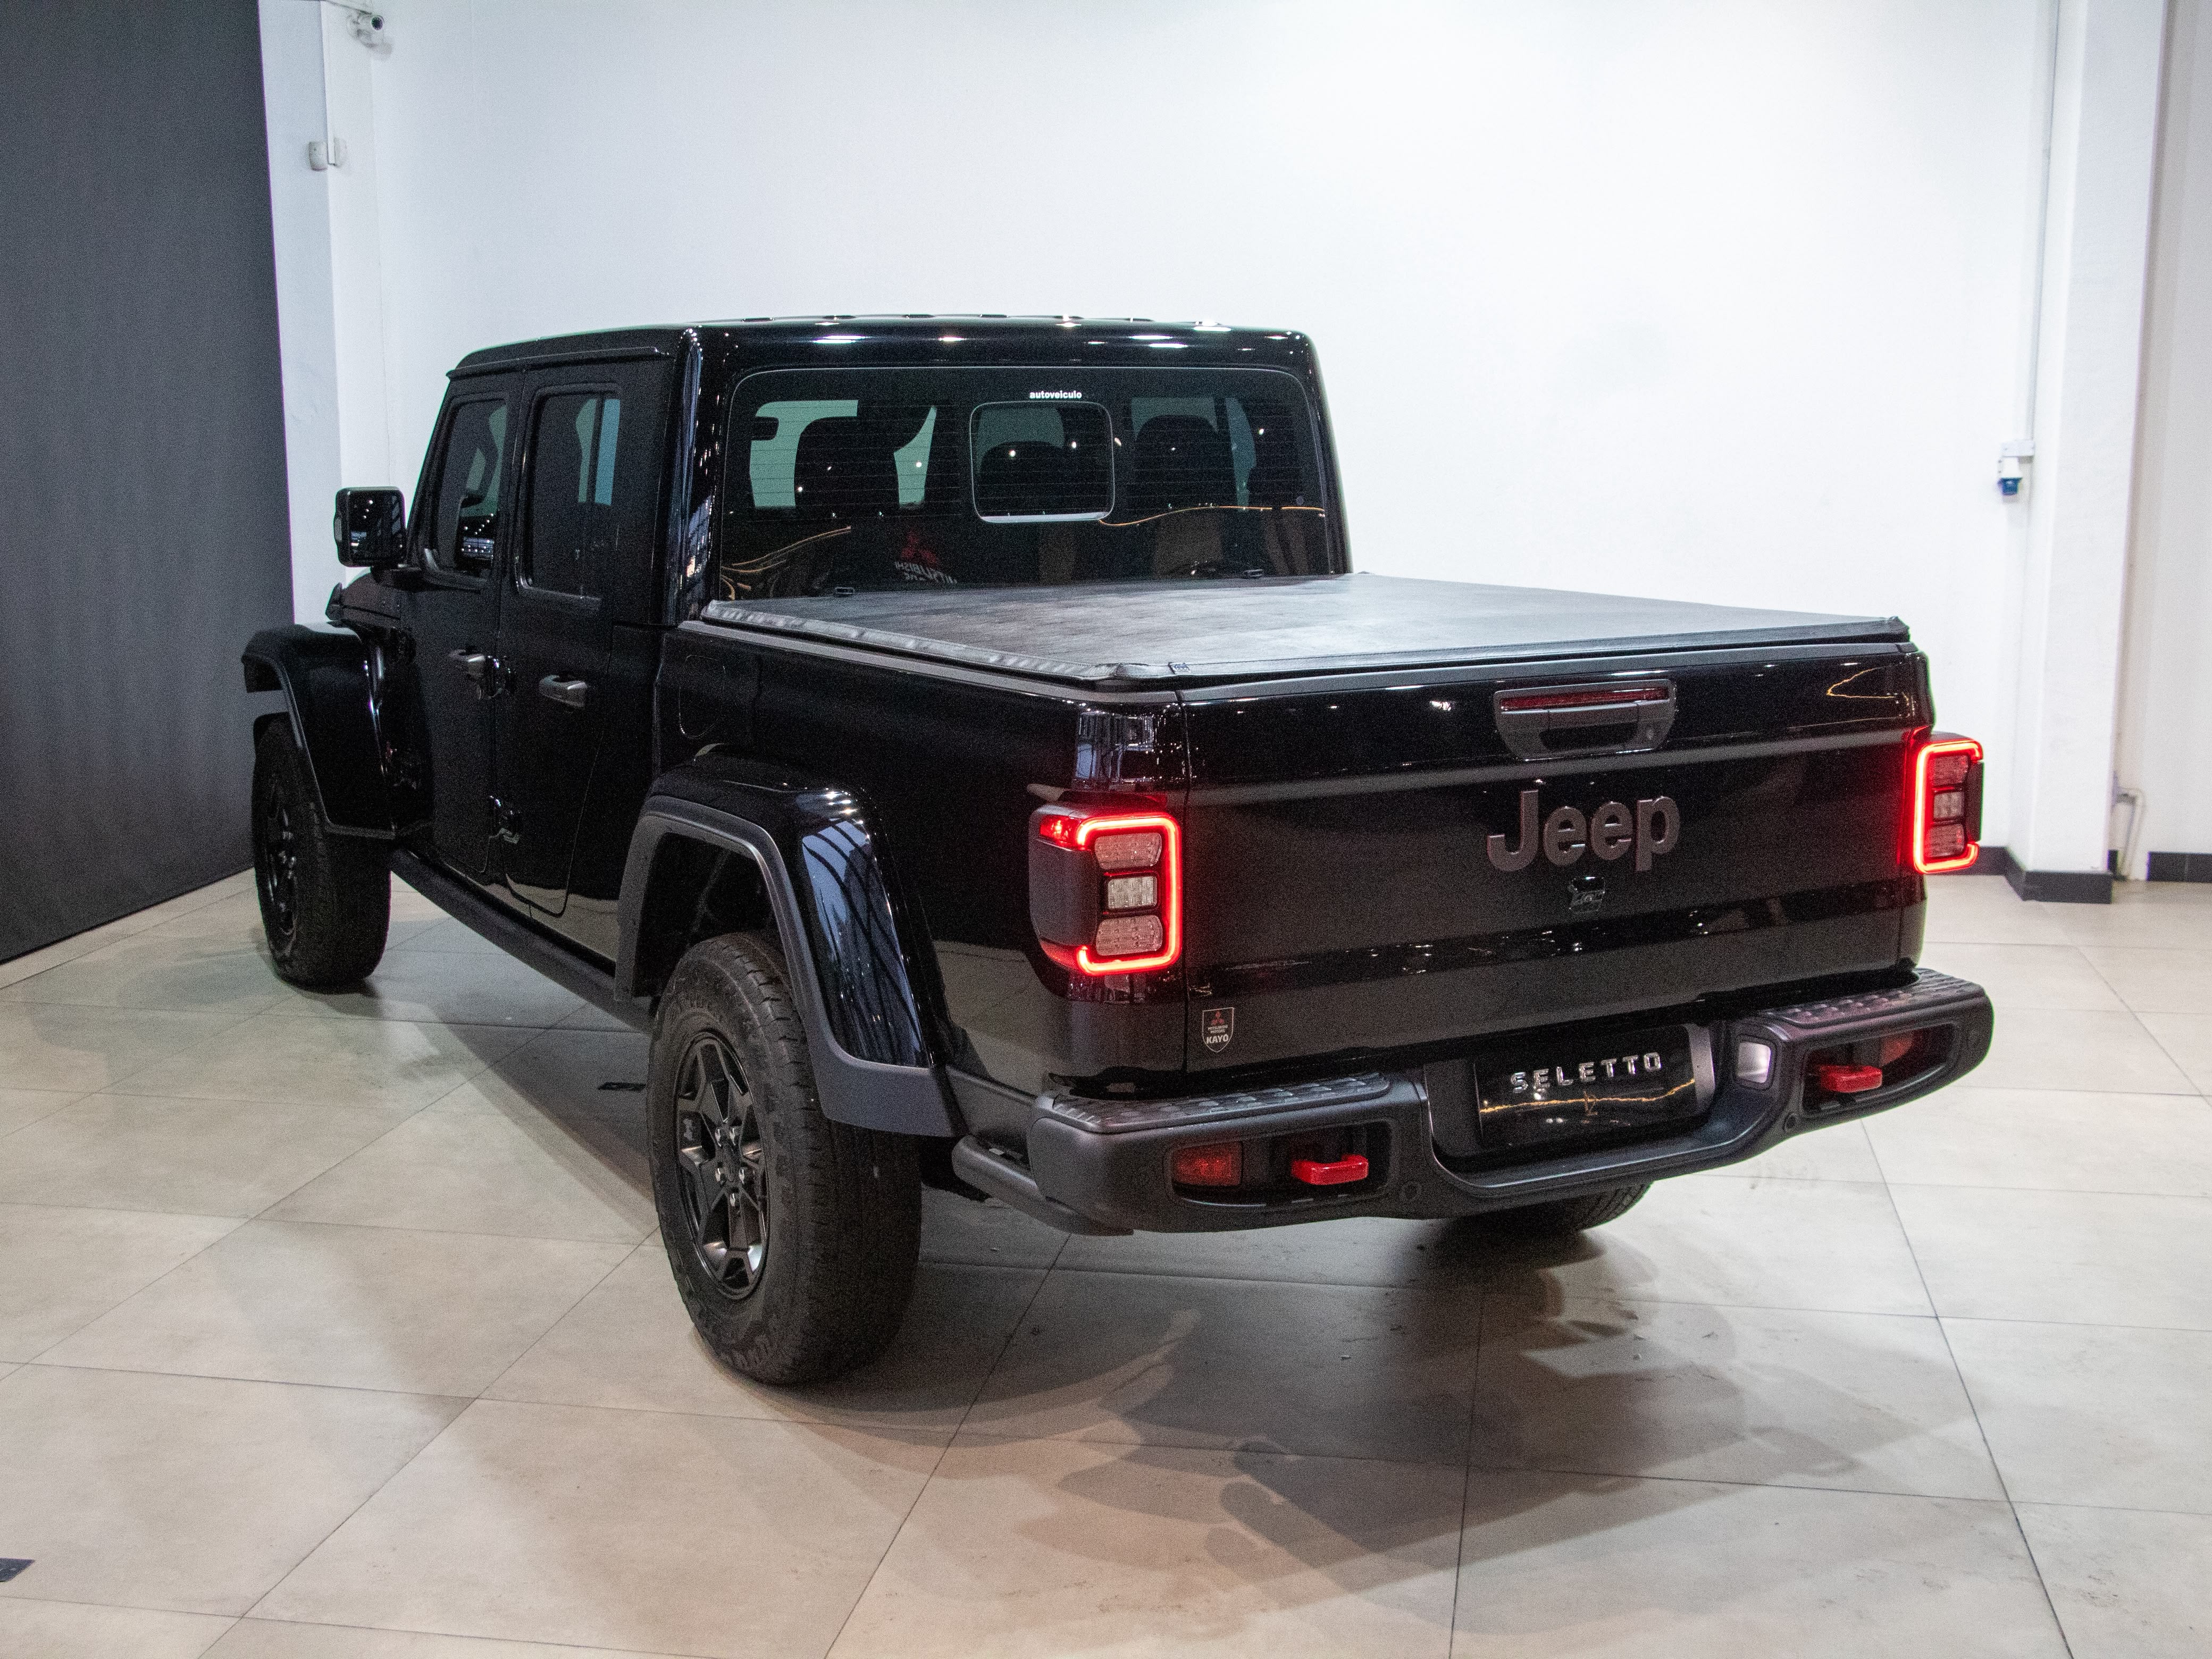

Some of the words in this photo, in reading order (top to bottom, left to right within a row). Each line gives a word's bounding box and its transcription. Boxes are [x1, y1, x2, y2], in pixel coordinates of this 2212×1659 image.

[1487, 789, 1680, 873] Jeep
[1206, 1034, 1229, 1044] KAYO
[1510, 1052, 1662, 1093] SELETTO
